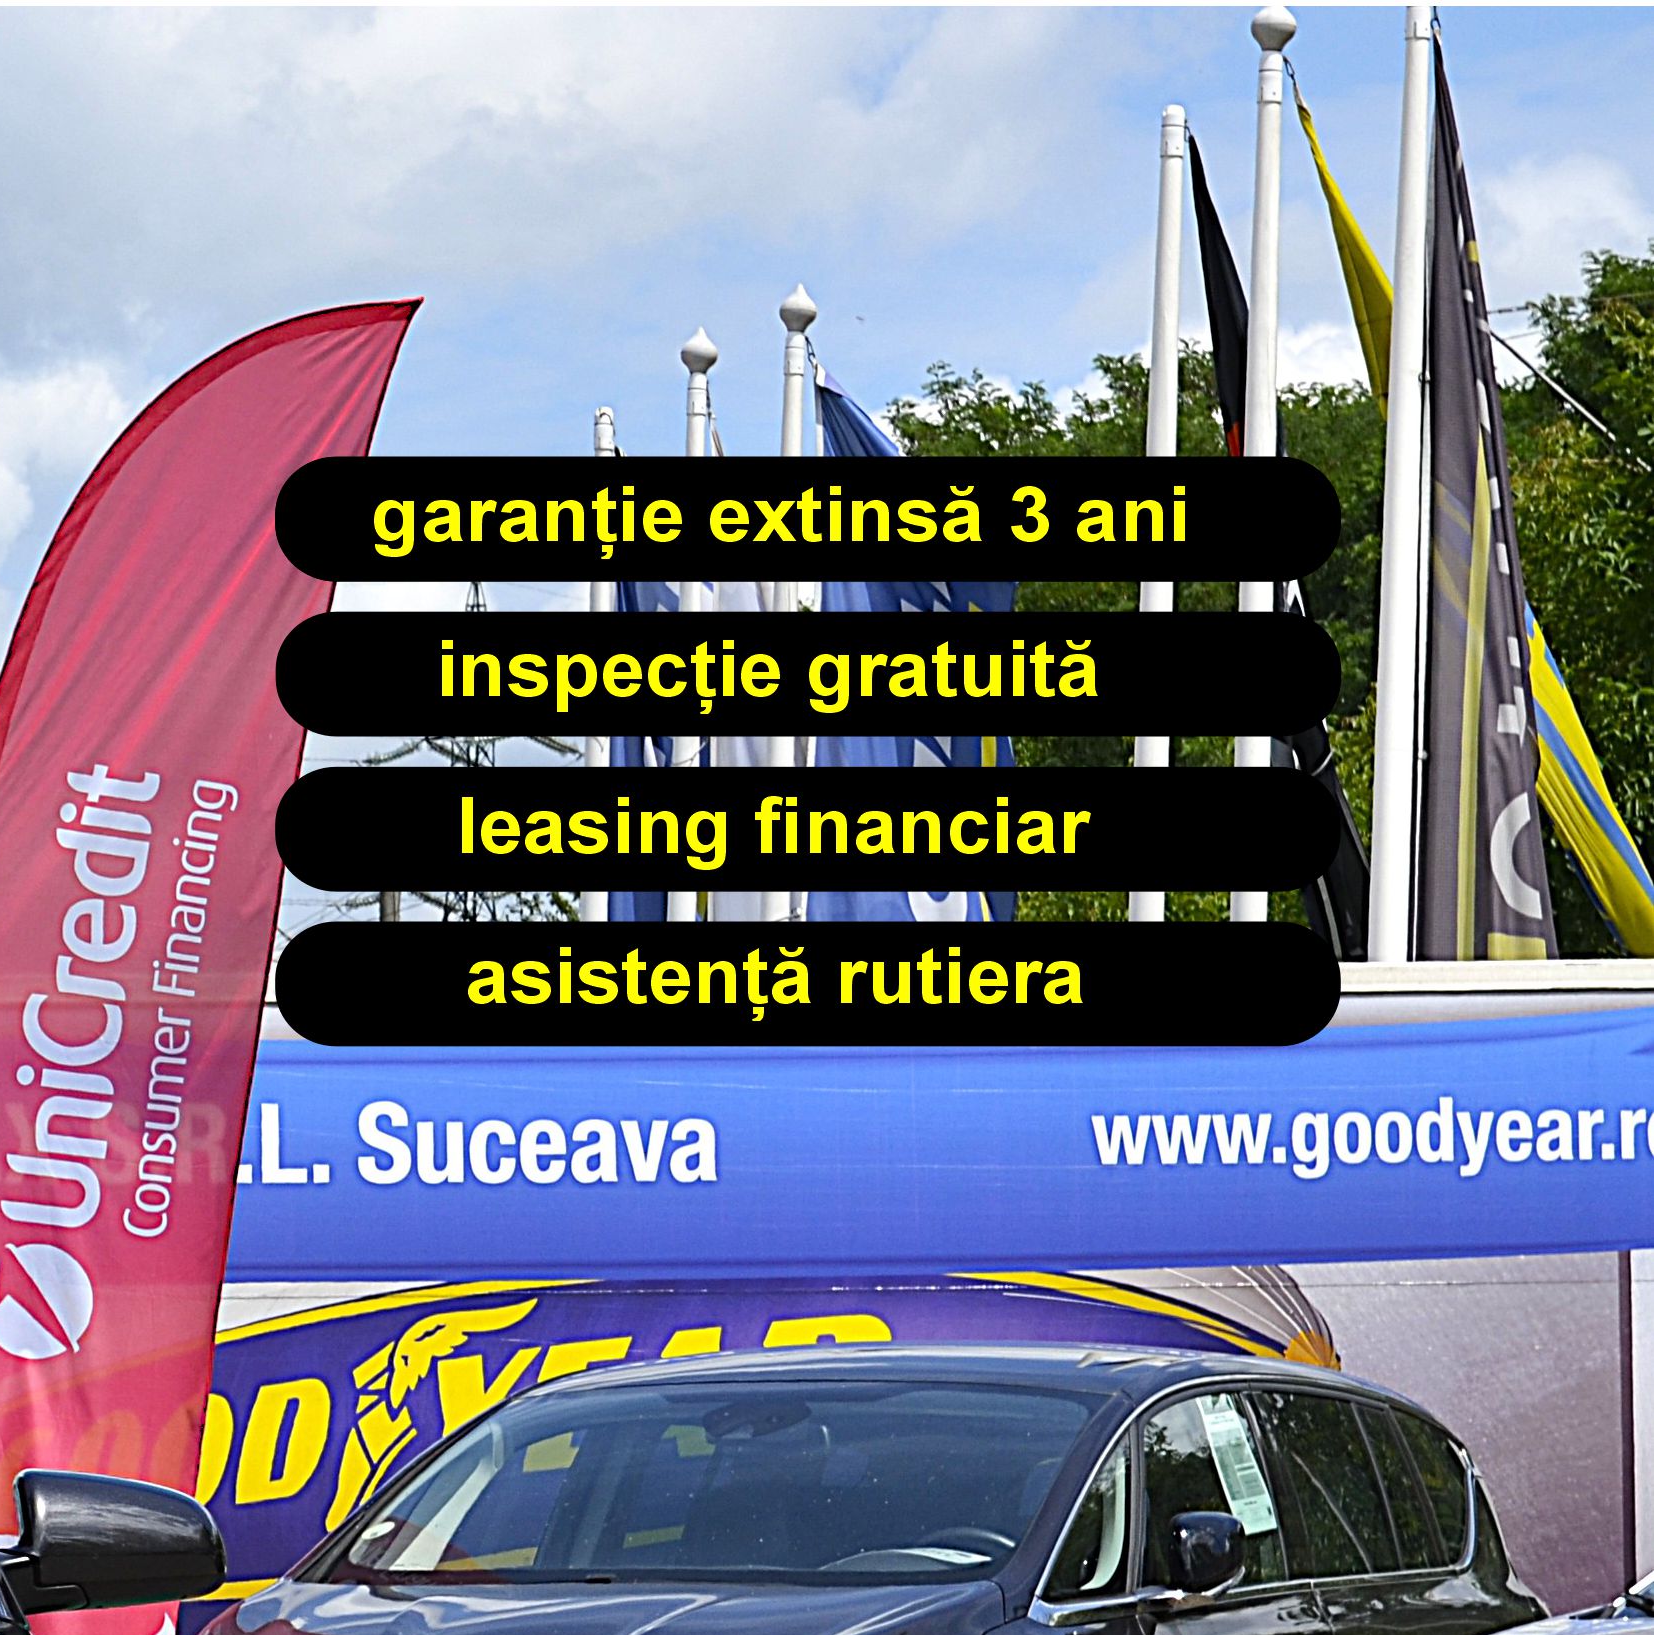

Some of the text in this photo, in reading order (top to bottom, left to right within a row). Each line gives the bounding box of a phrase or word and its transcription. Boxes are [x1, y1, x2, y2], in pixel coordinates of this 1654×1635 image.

[0, 764, 160, 1229] UniCredit
[123, 779, 239, 1238] Consumer Financing
[358, 1101, 717, 1184] Suceava
[1092, 1097, 1654, 1179] www.goodyear.r
